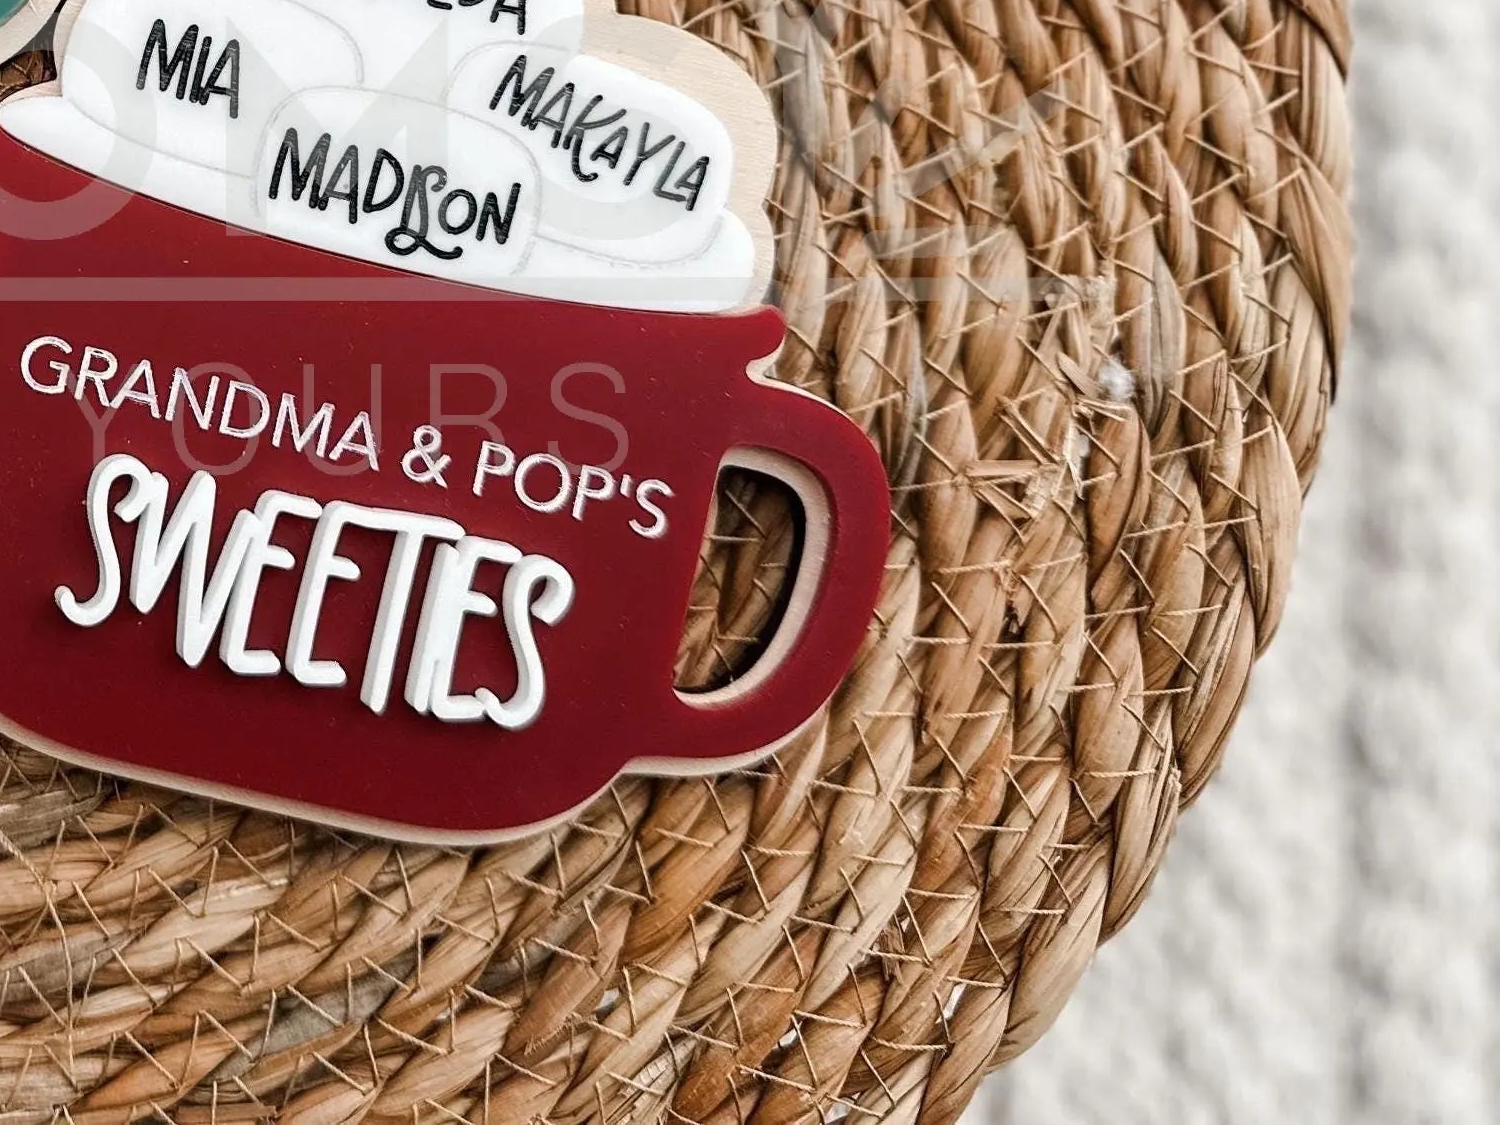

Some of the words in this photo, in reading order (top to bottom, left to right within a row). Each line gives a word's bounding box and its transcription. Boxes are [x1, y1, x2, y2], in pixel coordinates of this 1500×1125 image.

[135, 18, 240, 119] MIA
[488, 54, 710, 212] MAKAYLA
[268, 127, 521, 261] MADISON
[19, 335, 380, 473] GRANDMA
[401, 425, 451, 489] &
[471, 439, 676, 540] POP'S
[53, 452, 576, 732] SWEETIES
